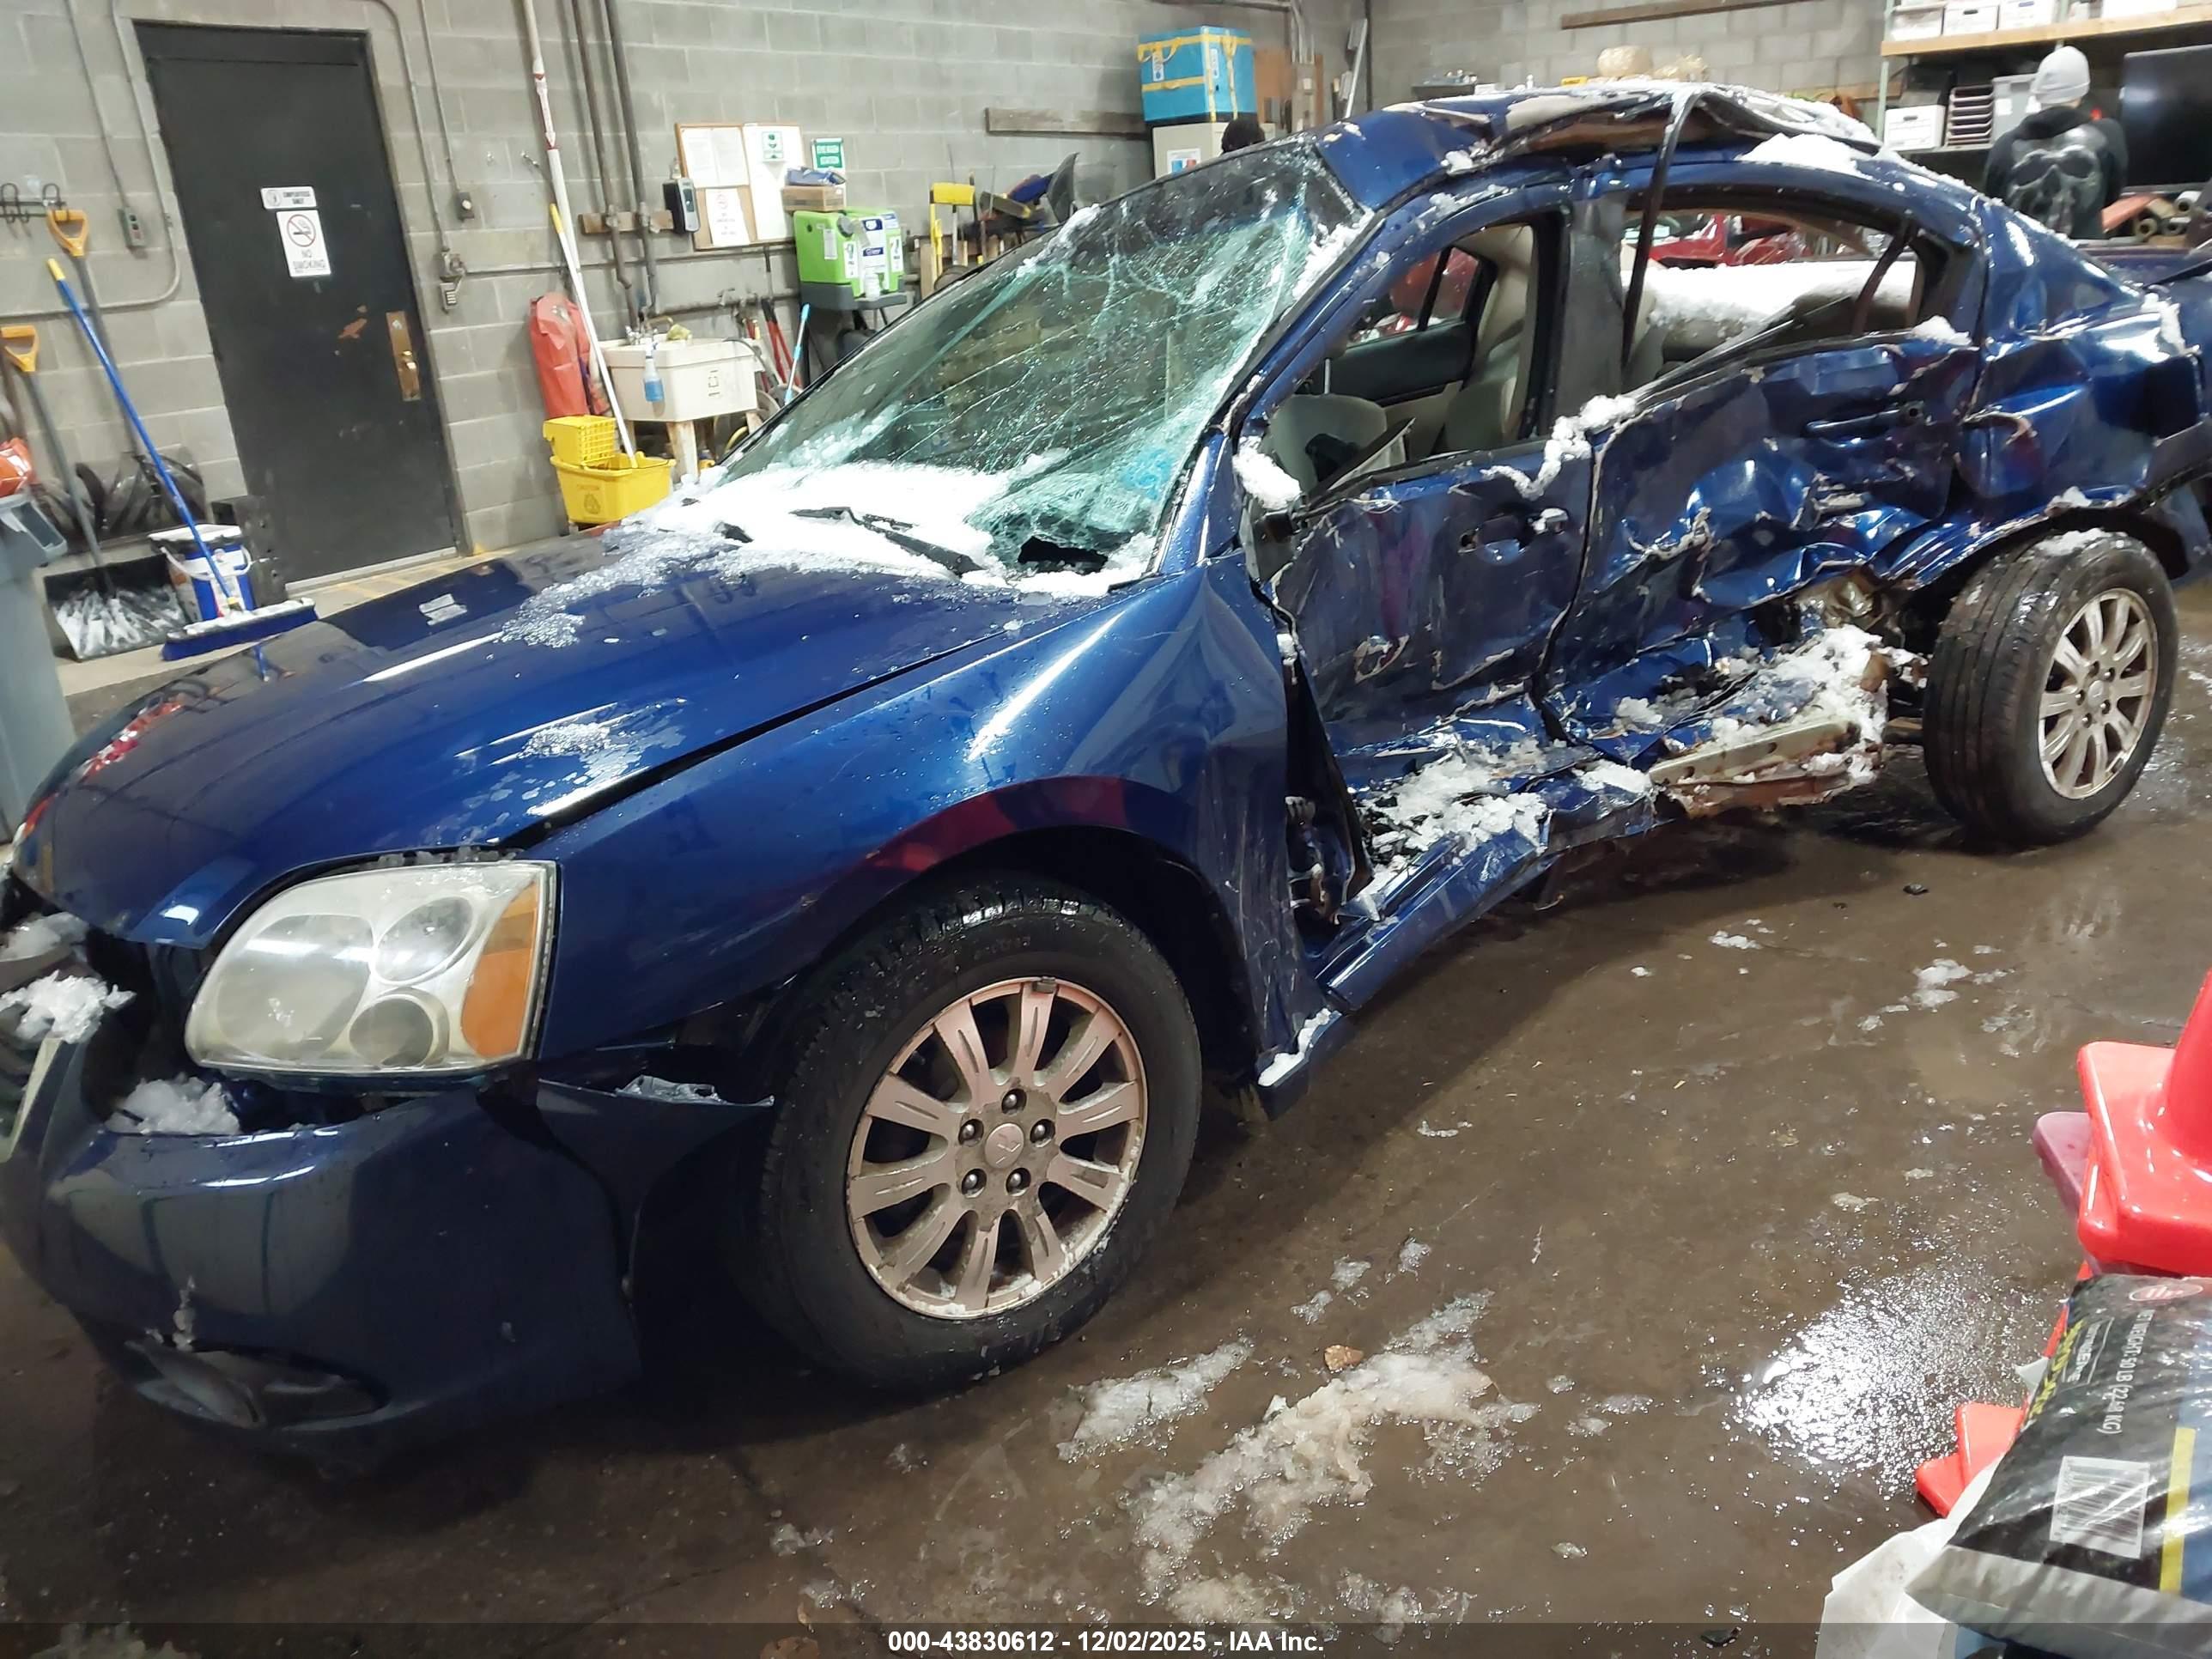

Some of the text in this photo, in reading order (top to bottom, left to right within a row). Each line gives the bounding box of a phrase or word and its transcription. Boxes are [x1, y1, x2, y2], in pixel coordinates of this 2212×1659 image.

[2118, 1358, 2137, 1369] 50
[2115, 1370, 2134, 1382] LB
[2096, 1414, 2123, 1435] KG)
